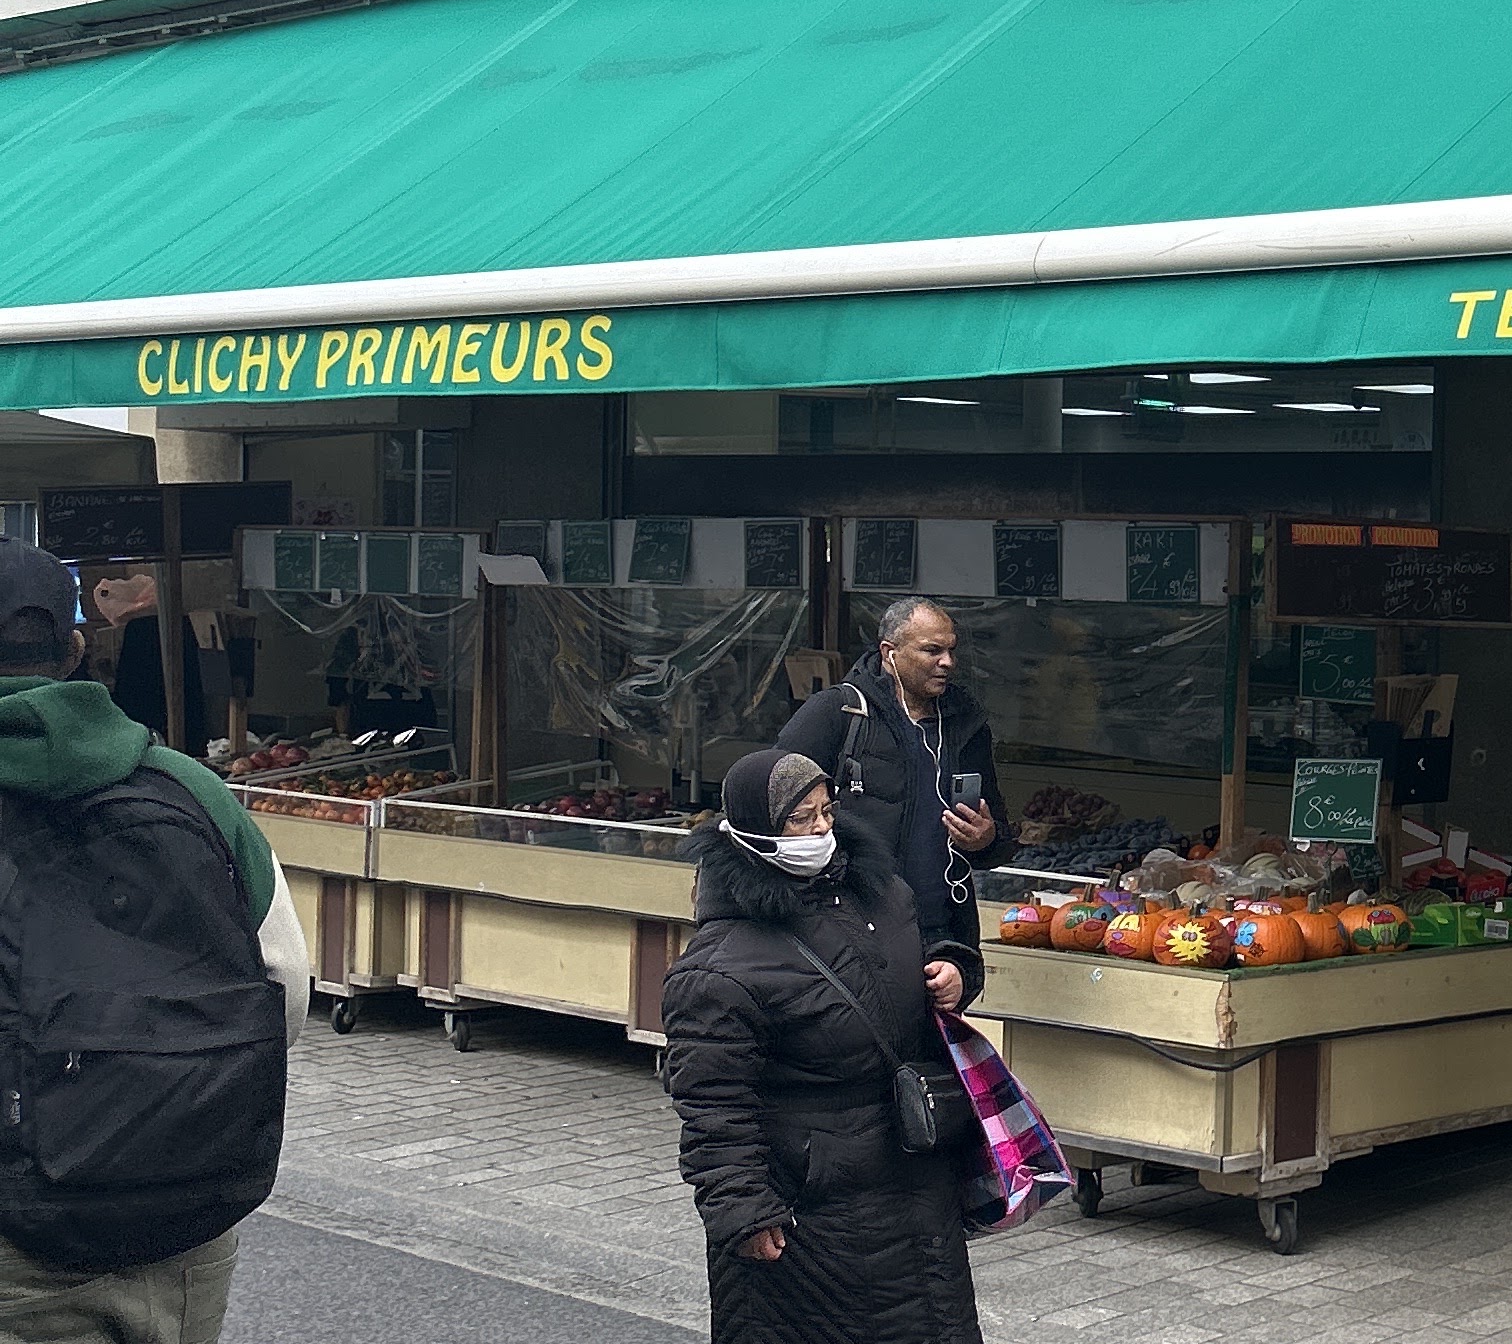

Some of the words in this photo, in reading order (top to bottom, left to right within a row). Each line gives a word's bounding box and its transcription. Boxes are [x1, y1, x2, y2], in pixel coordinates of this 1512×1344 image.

[137, 335, 307, 396] CLICHY
[315, 314, 614, 388] PRIMEURS
[1295, 525, 1358, 545] PROMOTION
[1375, 527, 1438, 547] PROMOTION
